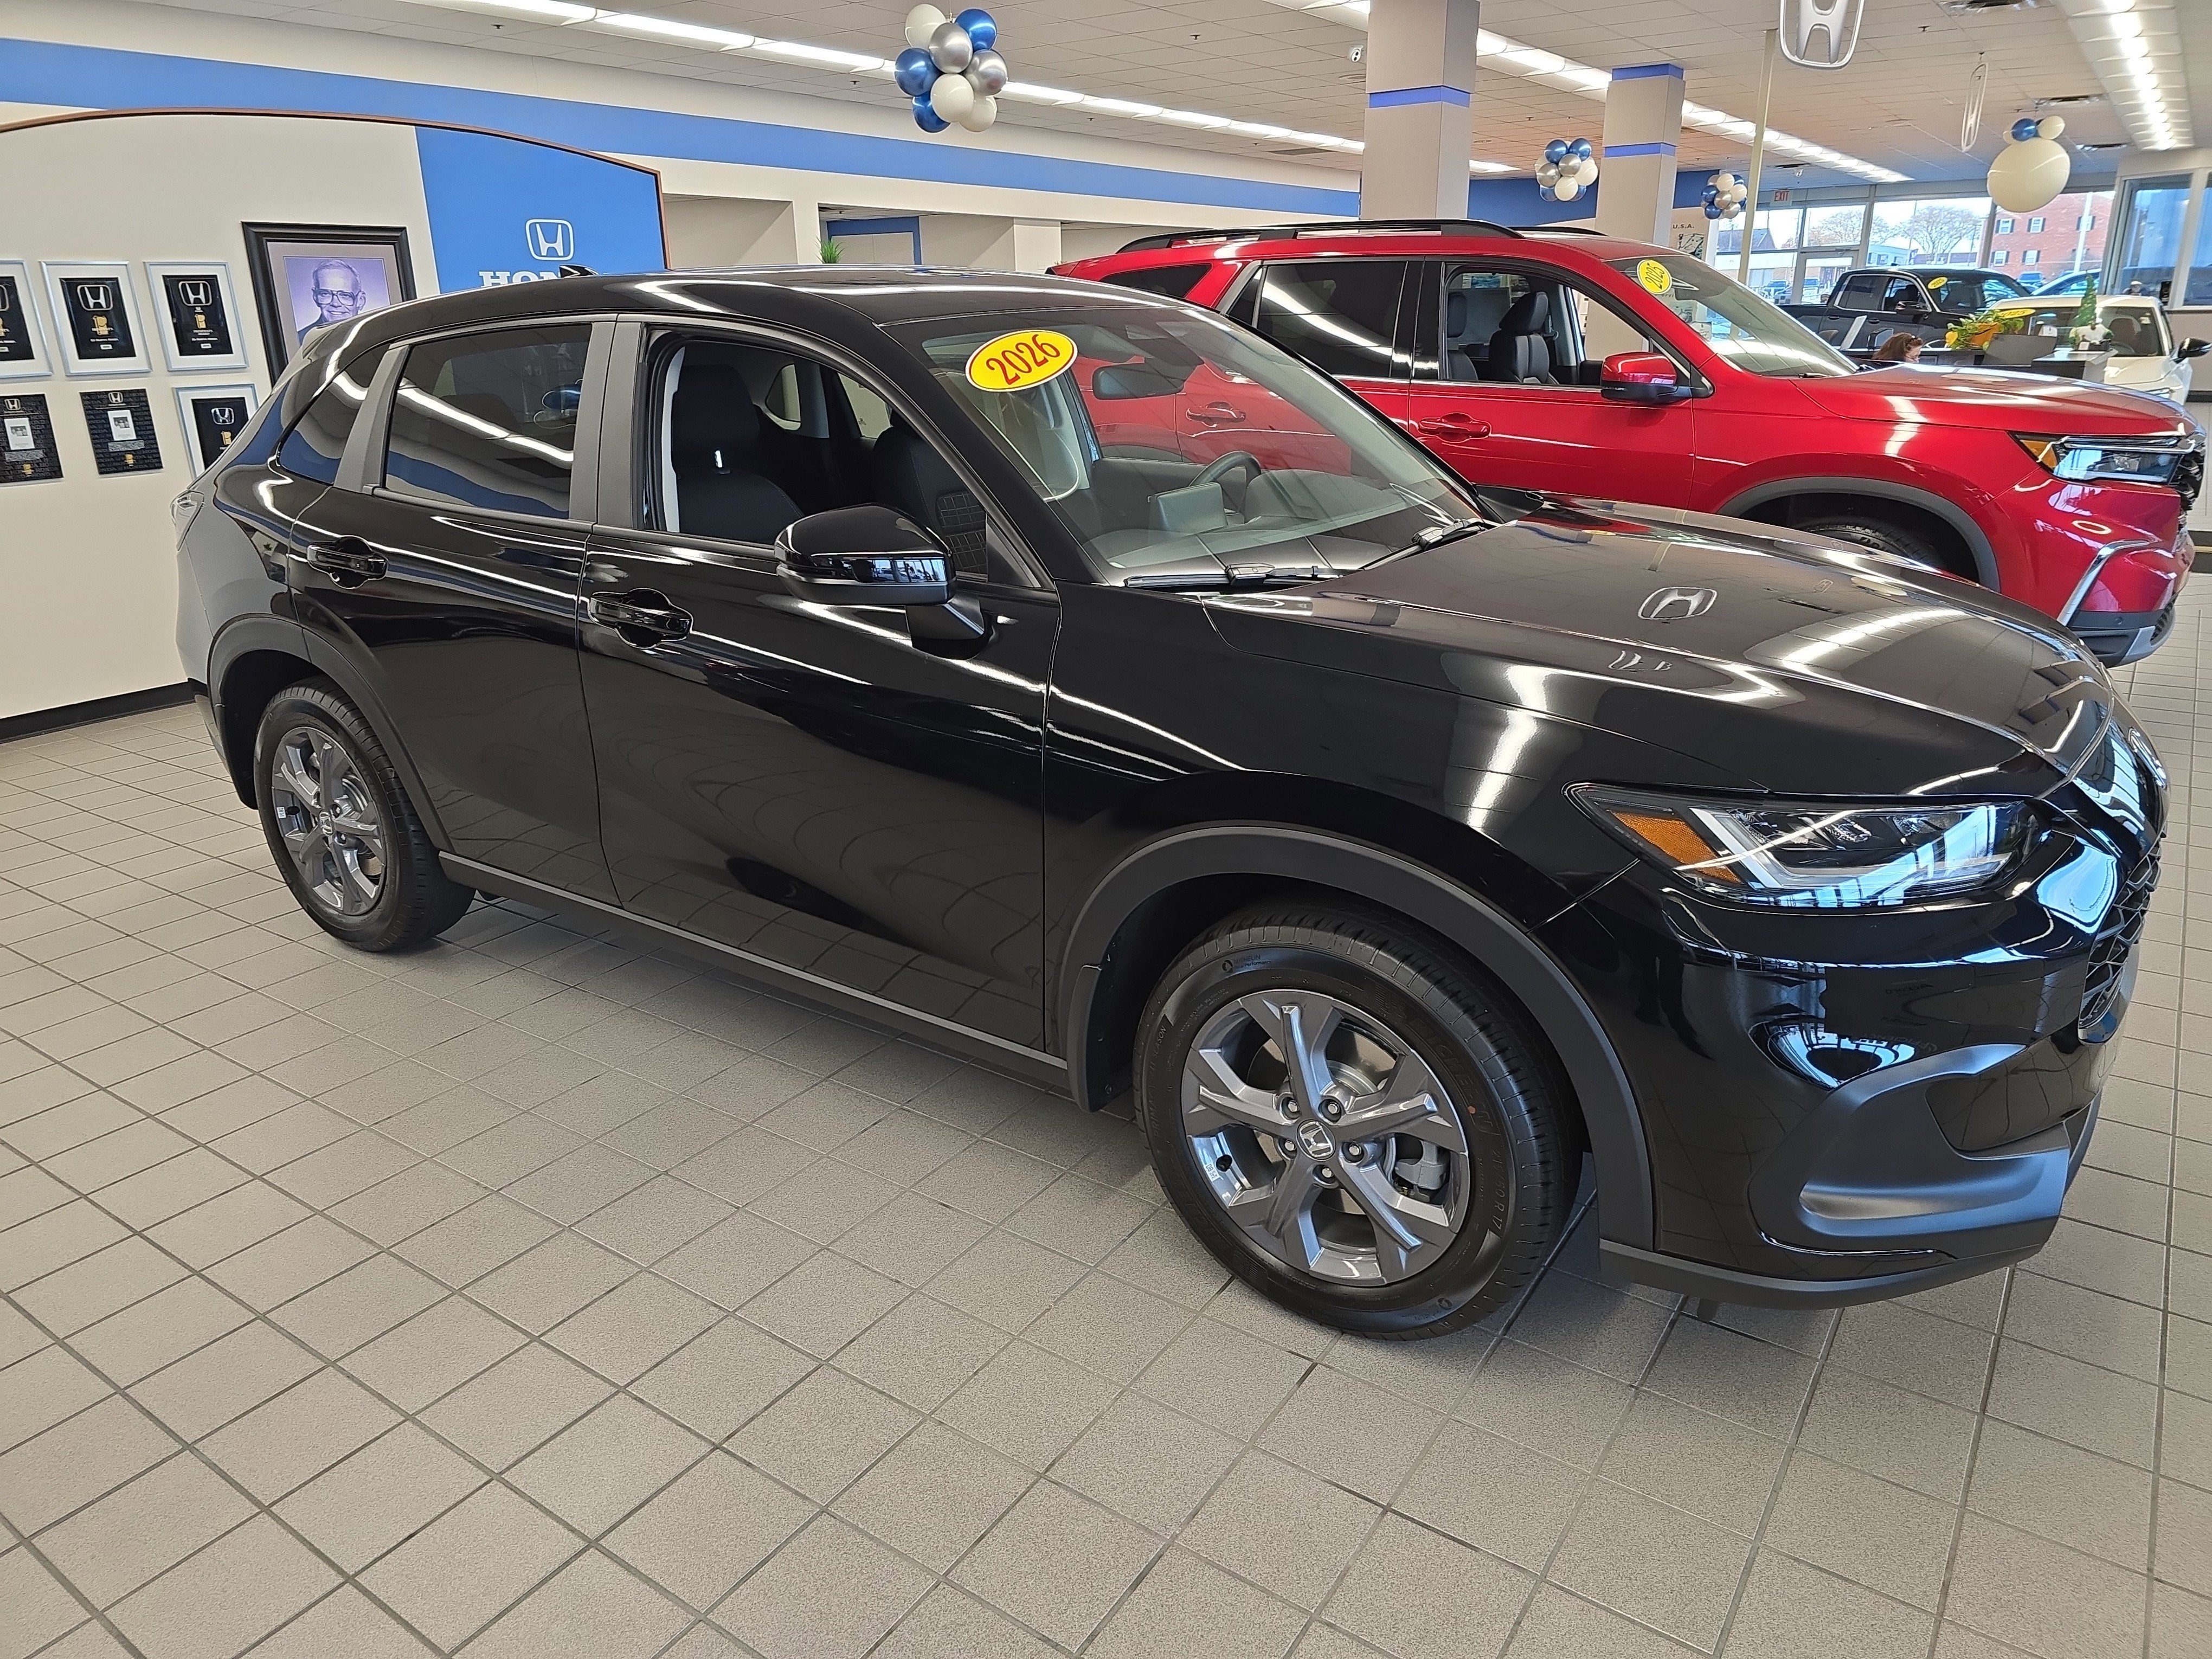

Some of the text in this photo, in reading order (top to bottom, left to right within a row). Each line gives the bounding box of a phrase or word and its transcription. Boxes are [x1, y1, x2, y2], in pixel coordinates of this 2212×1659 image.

[1774, 191, 1789, 201] EXIT
[1645, 262, 1665, 290] 2025
[986, 334, 1060, 385] 2026
[1153, 1025, 1166, 1058] SEASON
[1494, 1201, 1504, 1211] R
[1492, 1215, 1502, 1229] 17
